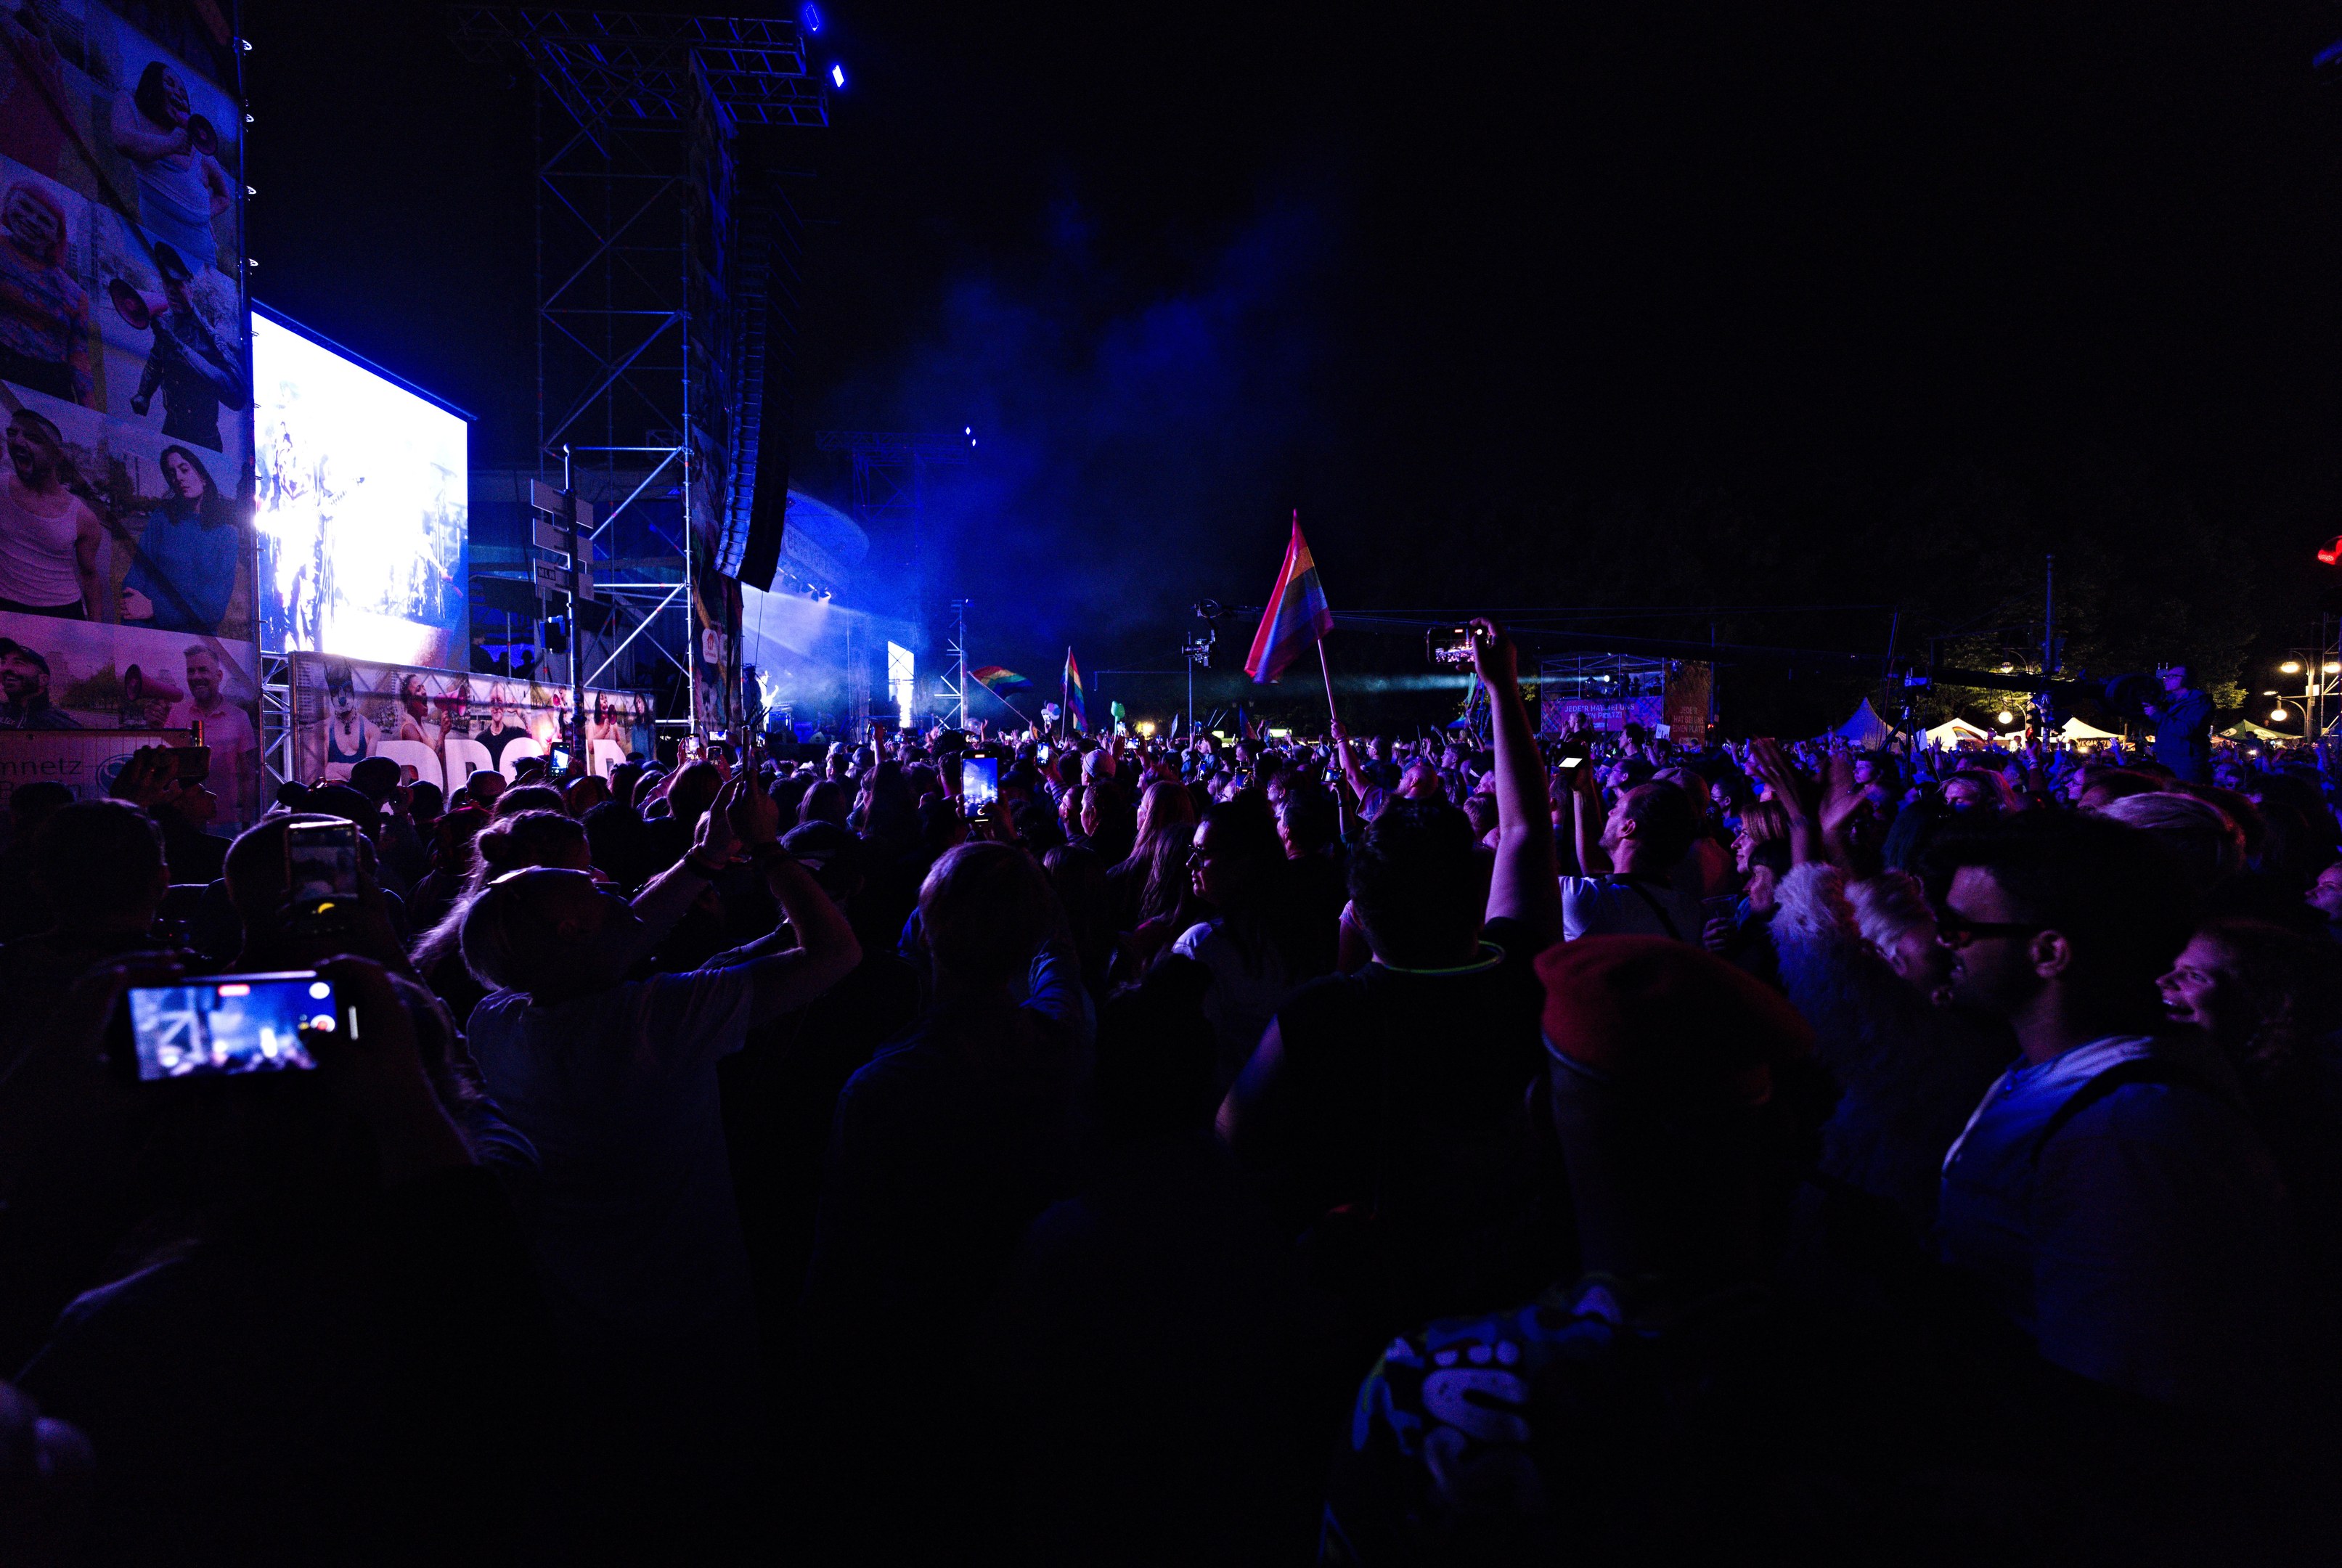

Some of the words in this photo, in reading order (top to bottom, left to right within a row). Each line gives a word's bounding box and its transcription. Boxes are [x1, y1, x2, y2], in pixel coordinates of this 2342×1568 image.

[1674, 715, 1684, 724] HAT
[1684, 715, 1693, 724] BEI
[1694, 716, 1704, 724] UNS
